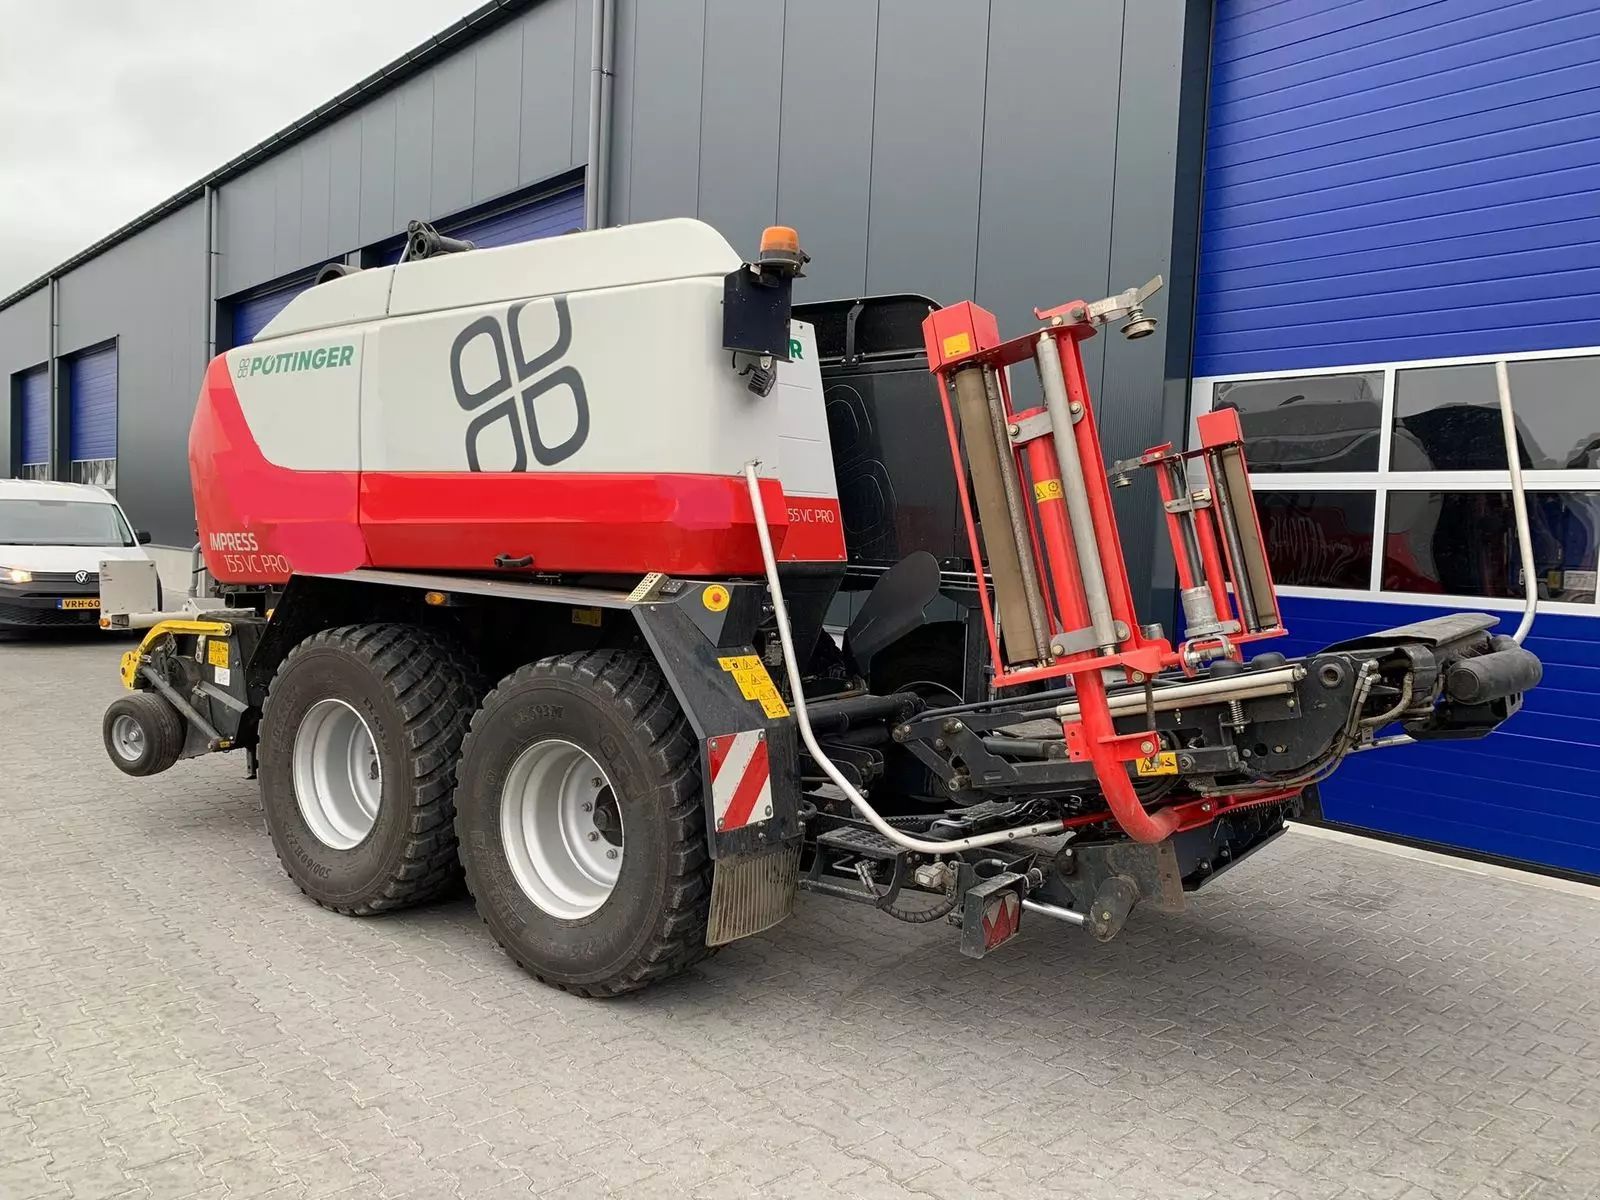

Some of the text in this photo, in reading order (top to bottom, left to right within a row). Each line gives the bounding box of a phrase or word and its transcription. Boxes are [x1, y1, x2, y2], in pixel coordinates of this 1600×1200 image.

[787, 508, 835, 524] 55 VC PRO
[209, 532, 259, 551] IMPRESS
[224, 555, 290, 573] 155 VC PRO
